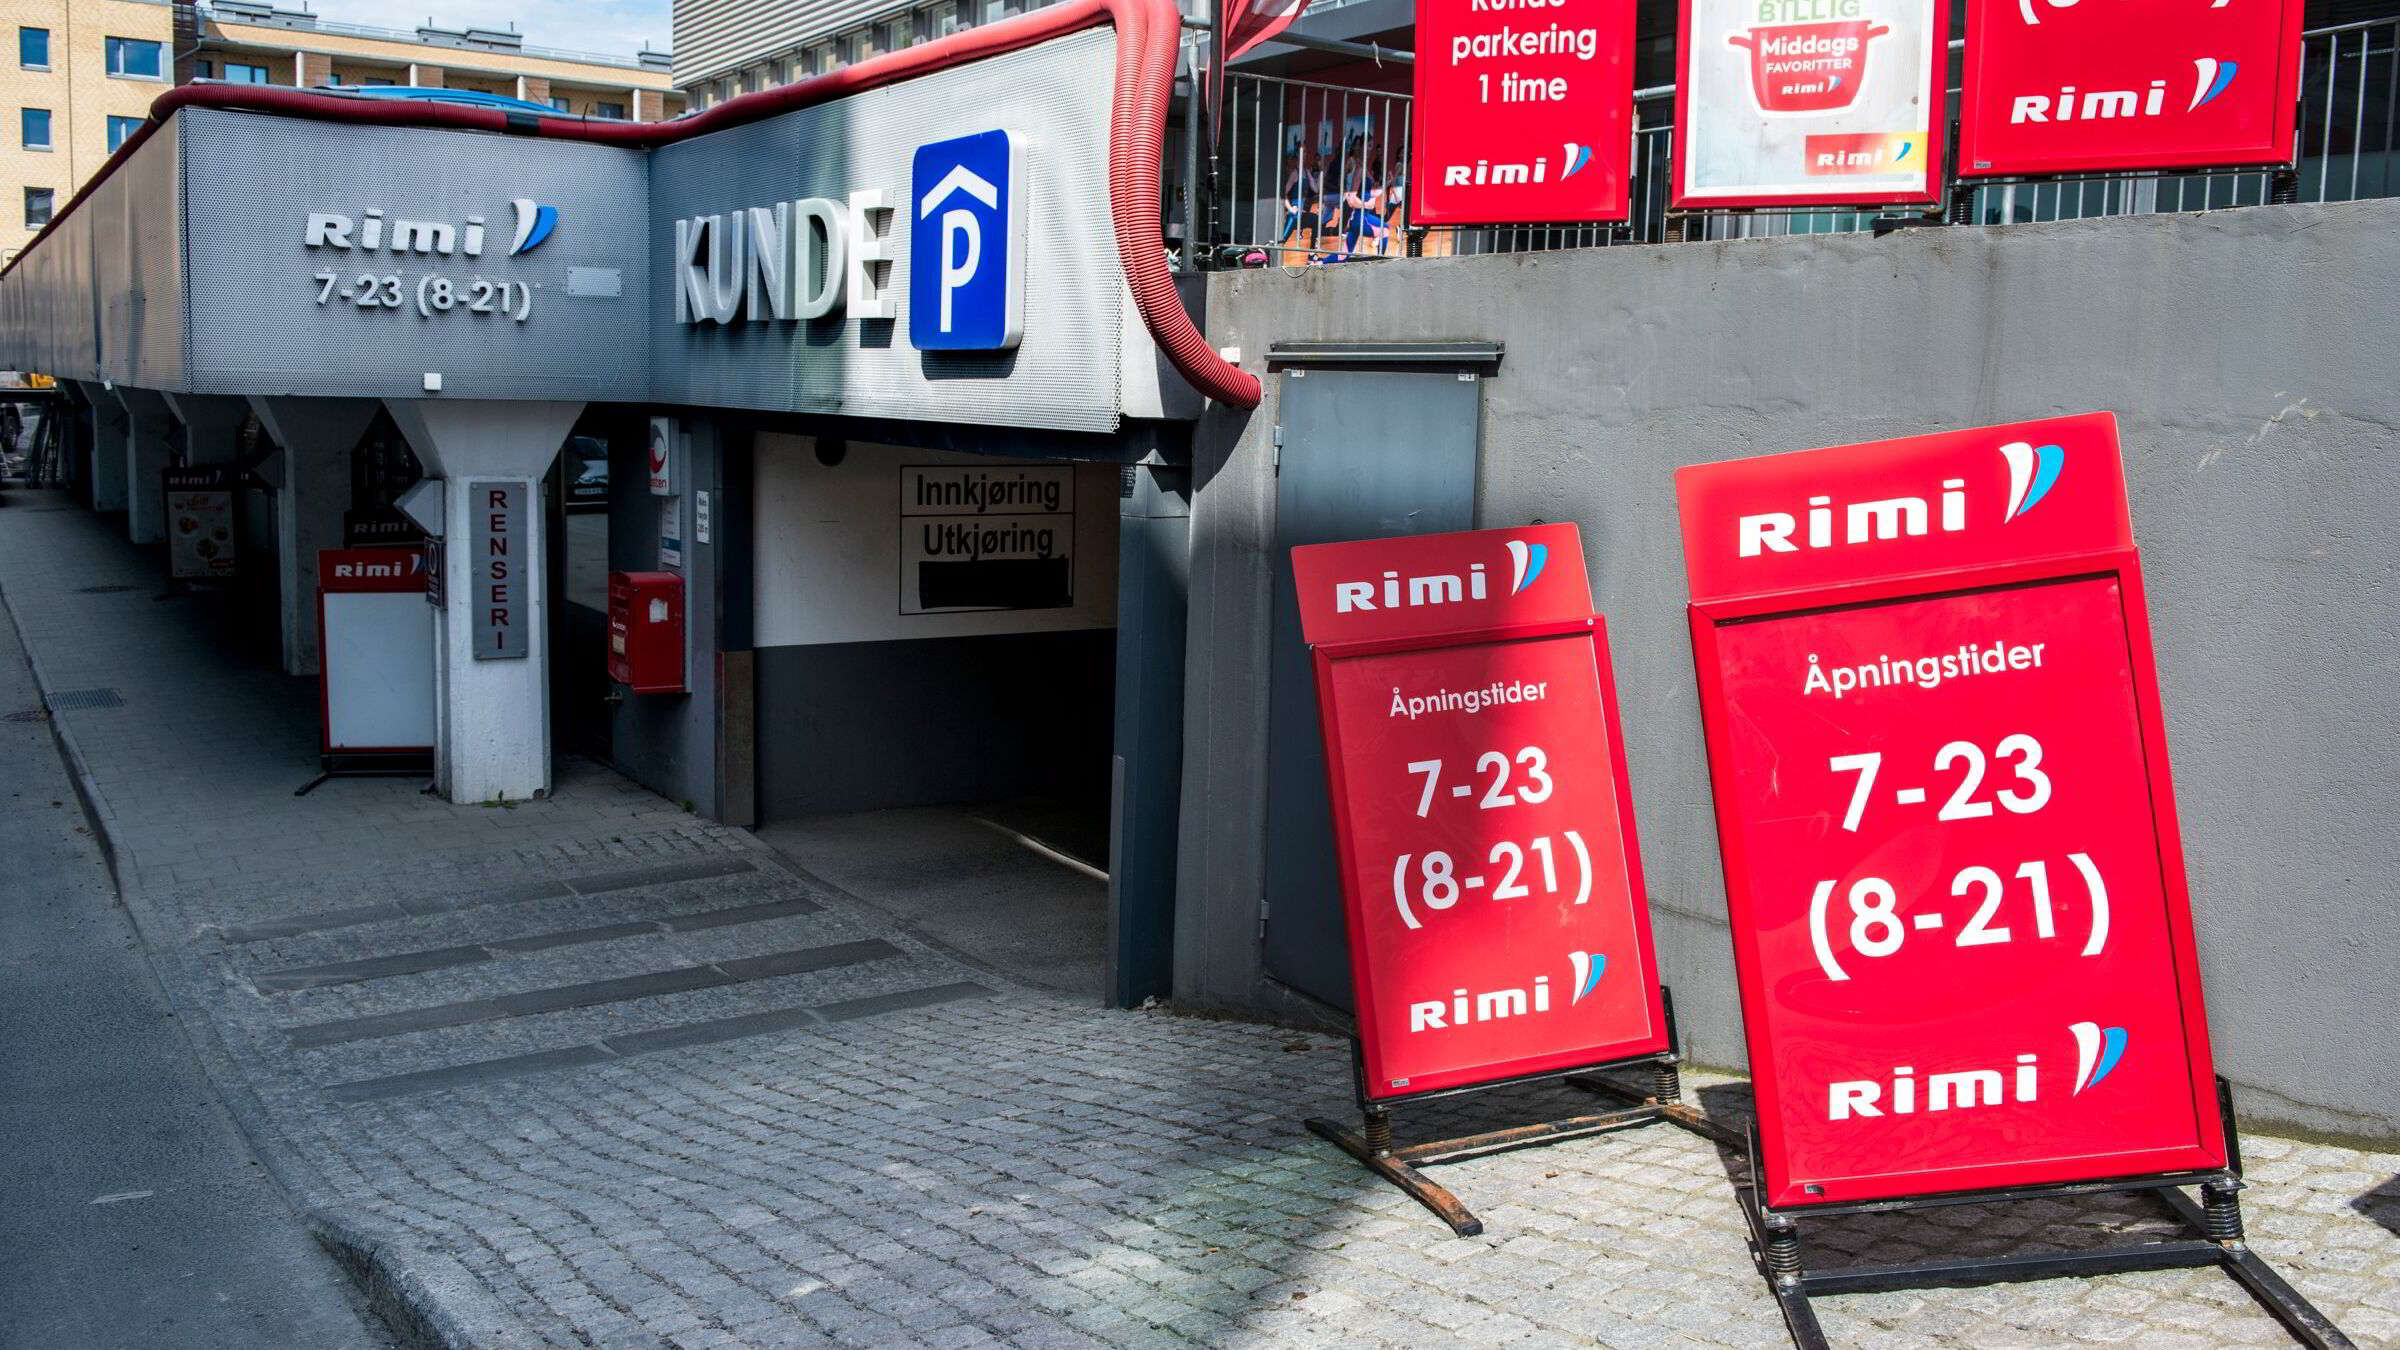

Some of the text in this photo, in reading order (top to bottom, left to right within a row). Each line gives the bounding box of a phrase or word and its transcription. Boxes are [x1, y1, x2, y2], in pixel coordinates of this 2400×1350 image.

[1452, 22, 1597, 66] parkering
[1761, 34, 1860, 57] Middags
[1765, 58, 1852, 74] FAVORITTER
[1478, 72, 1568, 103] 1 time
[1781, 82, 1825, 95] Rimi
[2010, 80, 2167, 124] Rimi
[1444, 157, 1547, 187] Rimi
[1816, 149, 1885, 167] Rimi
[304, 208, 486, 257] Rimi
[674, 188, 896, 325] KUNDE
[940, 208, 981, 333] P
[314, 273, 531, 322] 7-23 (8-21)
[916, 473, 1061, 513] Innkjøring
[1739, 478, 1965, 557] Rimi
[924, 522, 1053, 561] Utkjøring
[334, 561, 403, 577] Rimi
[489, 490, 509, 650] RENSERI
[1335, 563, 1487, 613] Rimi
[1803, 640, 2046, 699] Åpningstider
[1389, 681, 1548, 720] Åpningstider
[1406, 745, 1554, 818] 7-23
[1829, 733, 2052, 833] 7-23
[1392, 830, 1593, 930] (8-21)
[1808, 852, 2110, 982] (8-21)
[1410, 975, 1550, 1033] Rimi
[1828, 1053, 2037, 1121] Rimi
